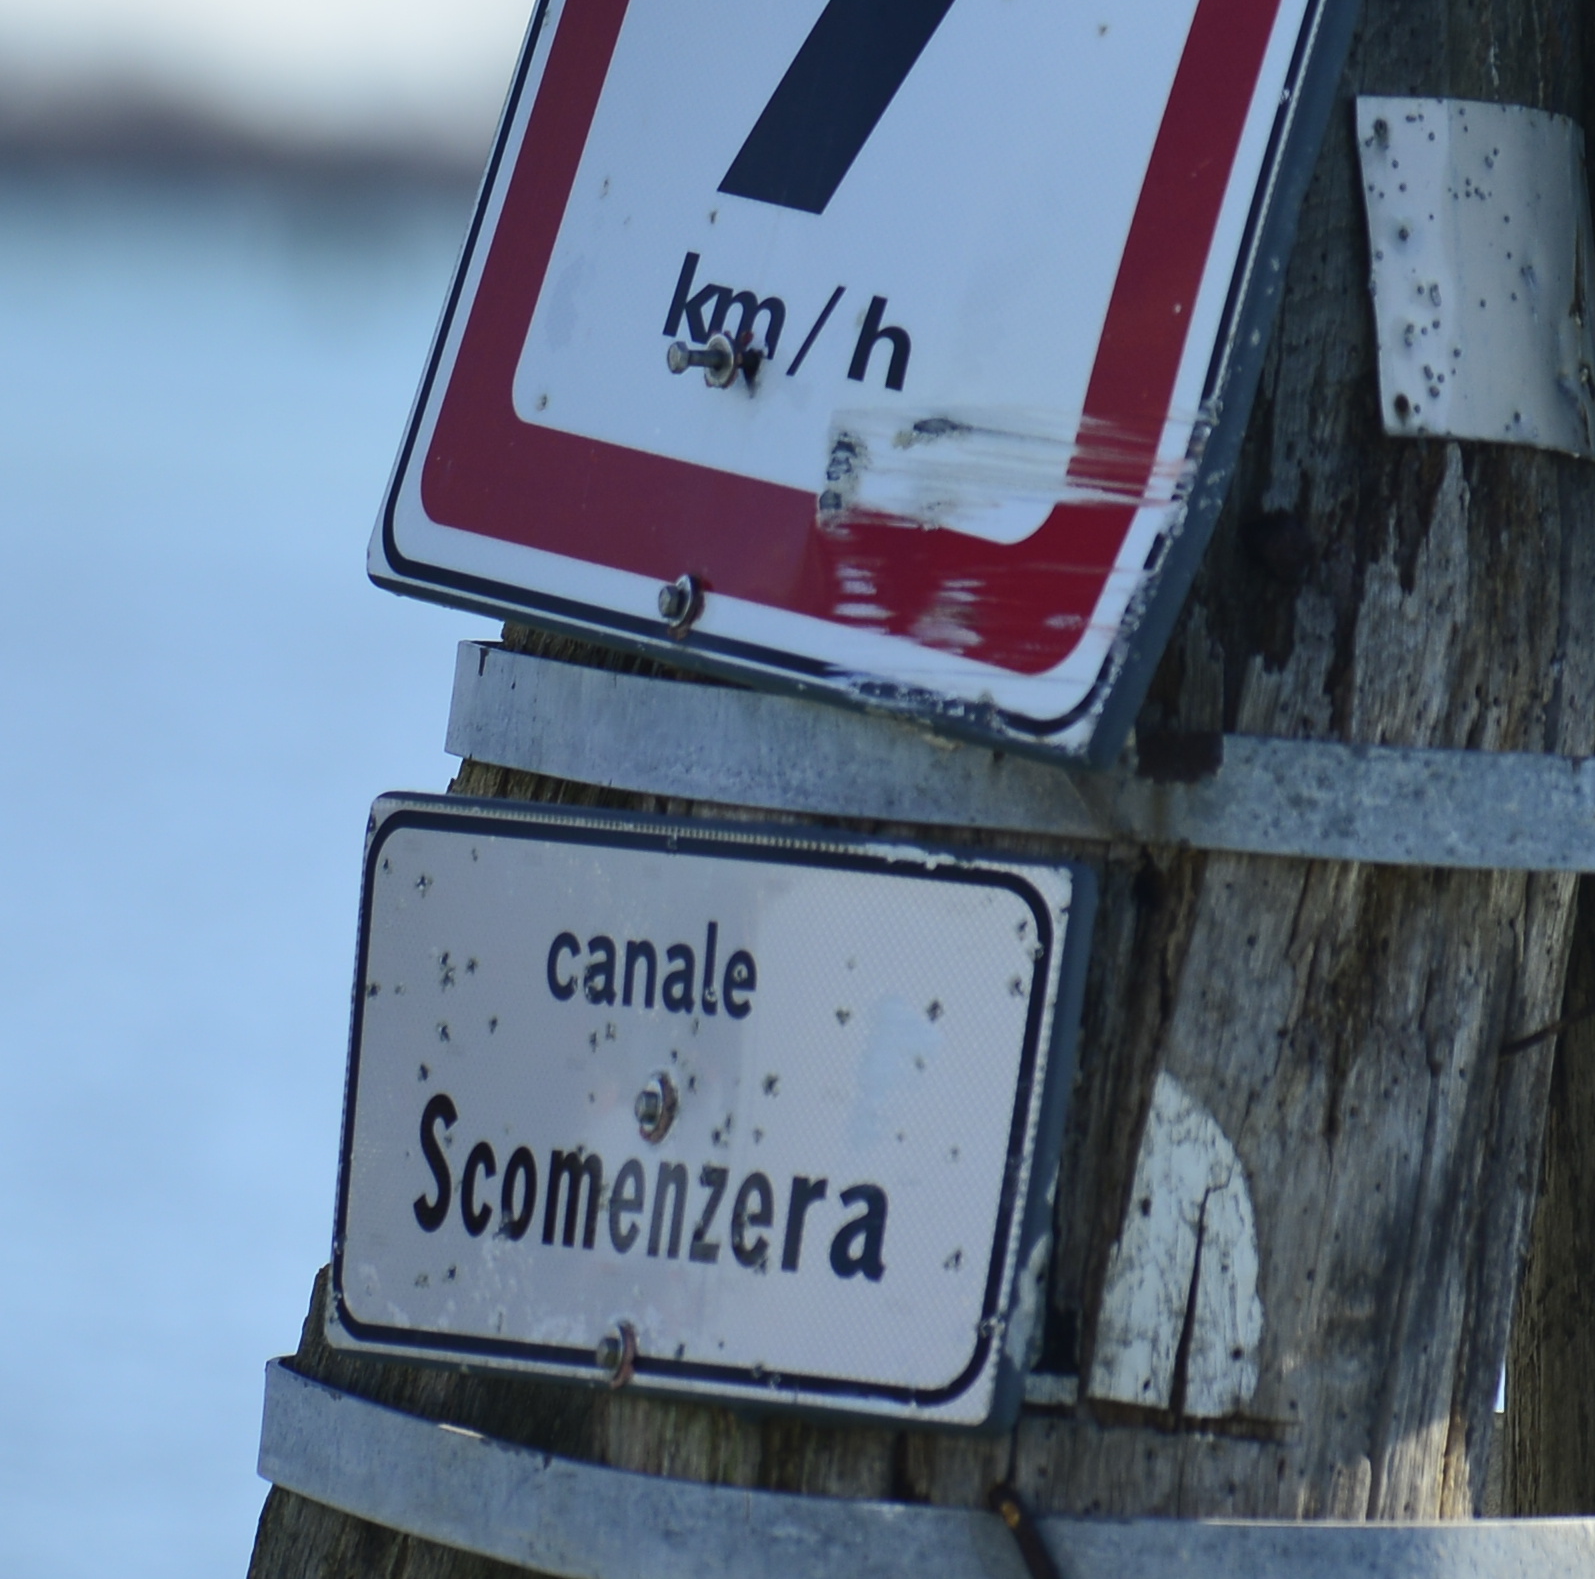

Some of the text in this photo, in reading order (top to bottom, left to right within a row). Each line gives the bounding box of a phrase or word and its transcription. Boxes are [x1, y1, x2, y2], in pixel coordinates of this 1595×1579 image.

[661, 250, 913, 392] km/h
[546, 921, 758, 1019] canale
[413, 1093, 890, 1282] Scomenzera
